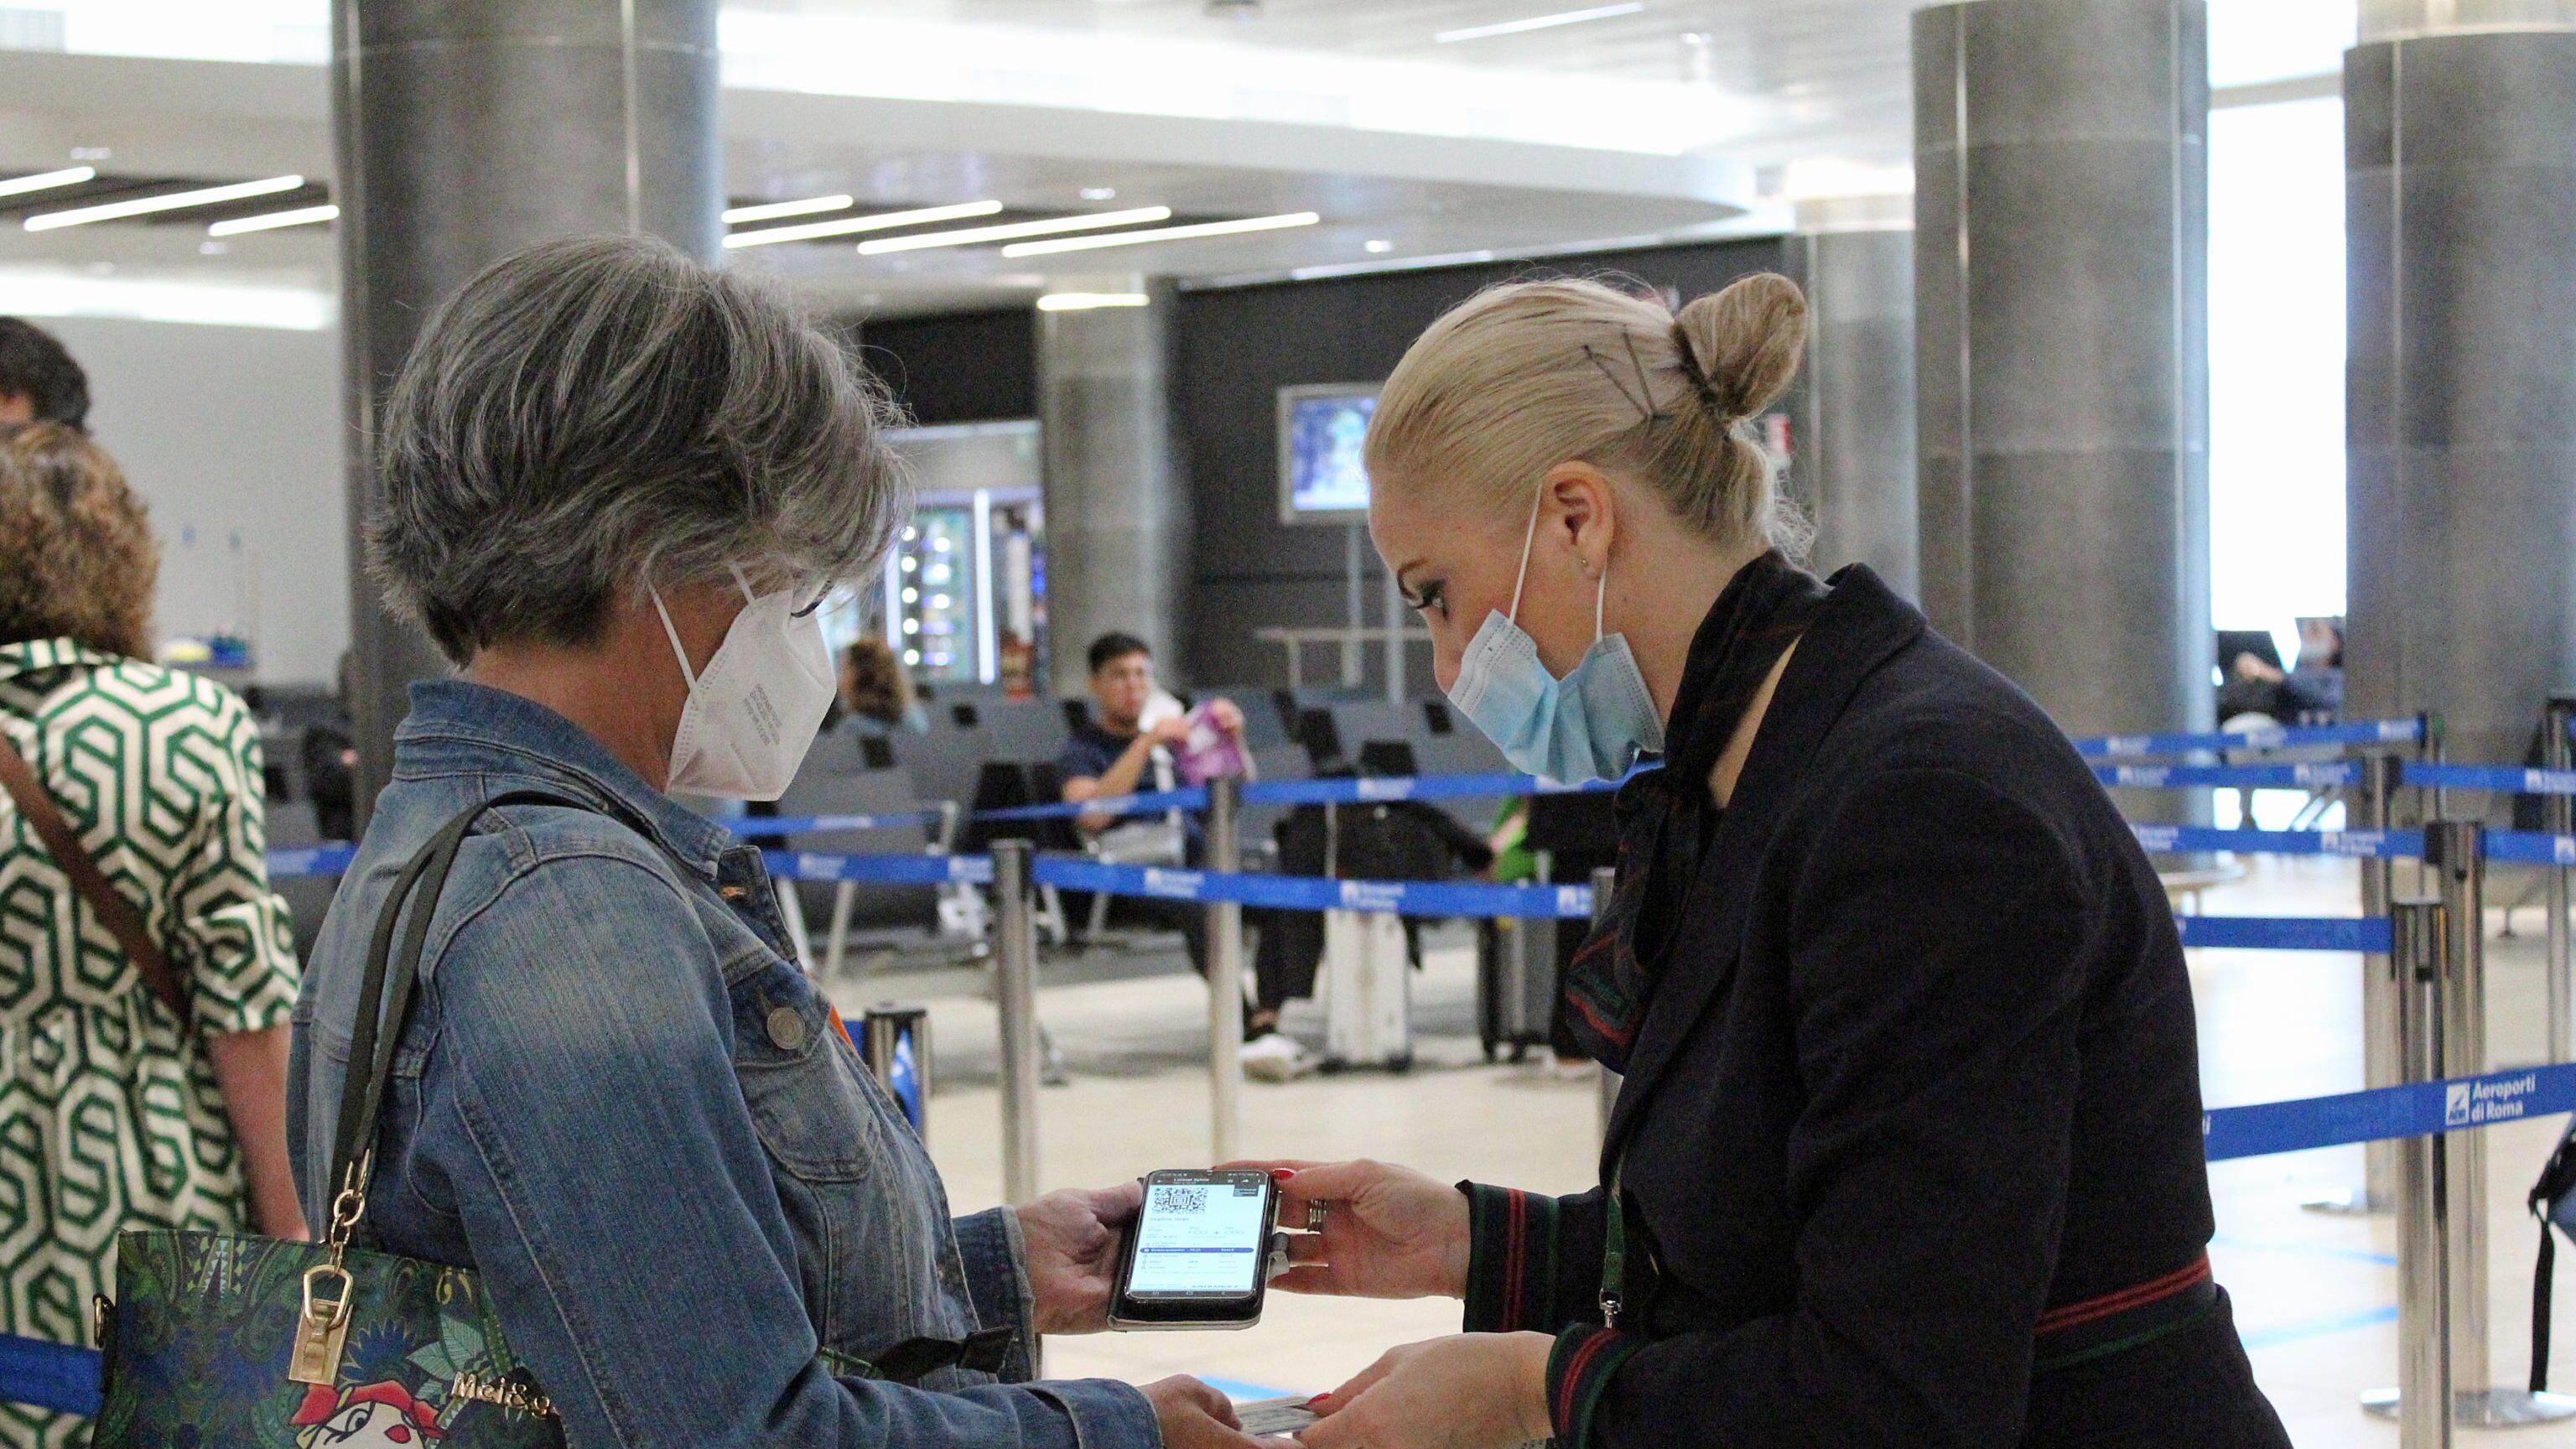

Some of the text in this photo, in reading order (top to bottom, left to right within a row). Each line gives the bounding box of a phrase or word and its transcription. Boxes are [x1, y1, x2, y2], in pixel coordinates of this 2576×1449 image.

[2473, 1072, 2536, 1101] Aeroporti
[2471, 1101, 2485, 1122] di
[2486, 1100, 2524, 1120] Roma
